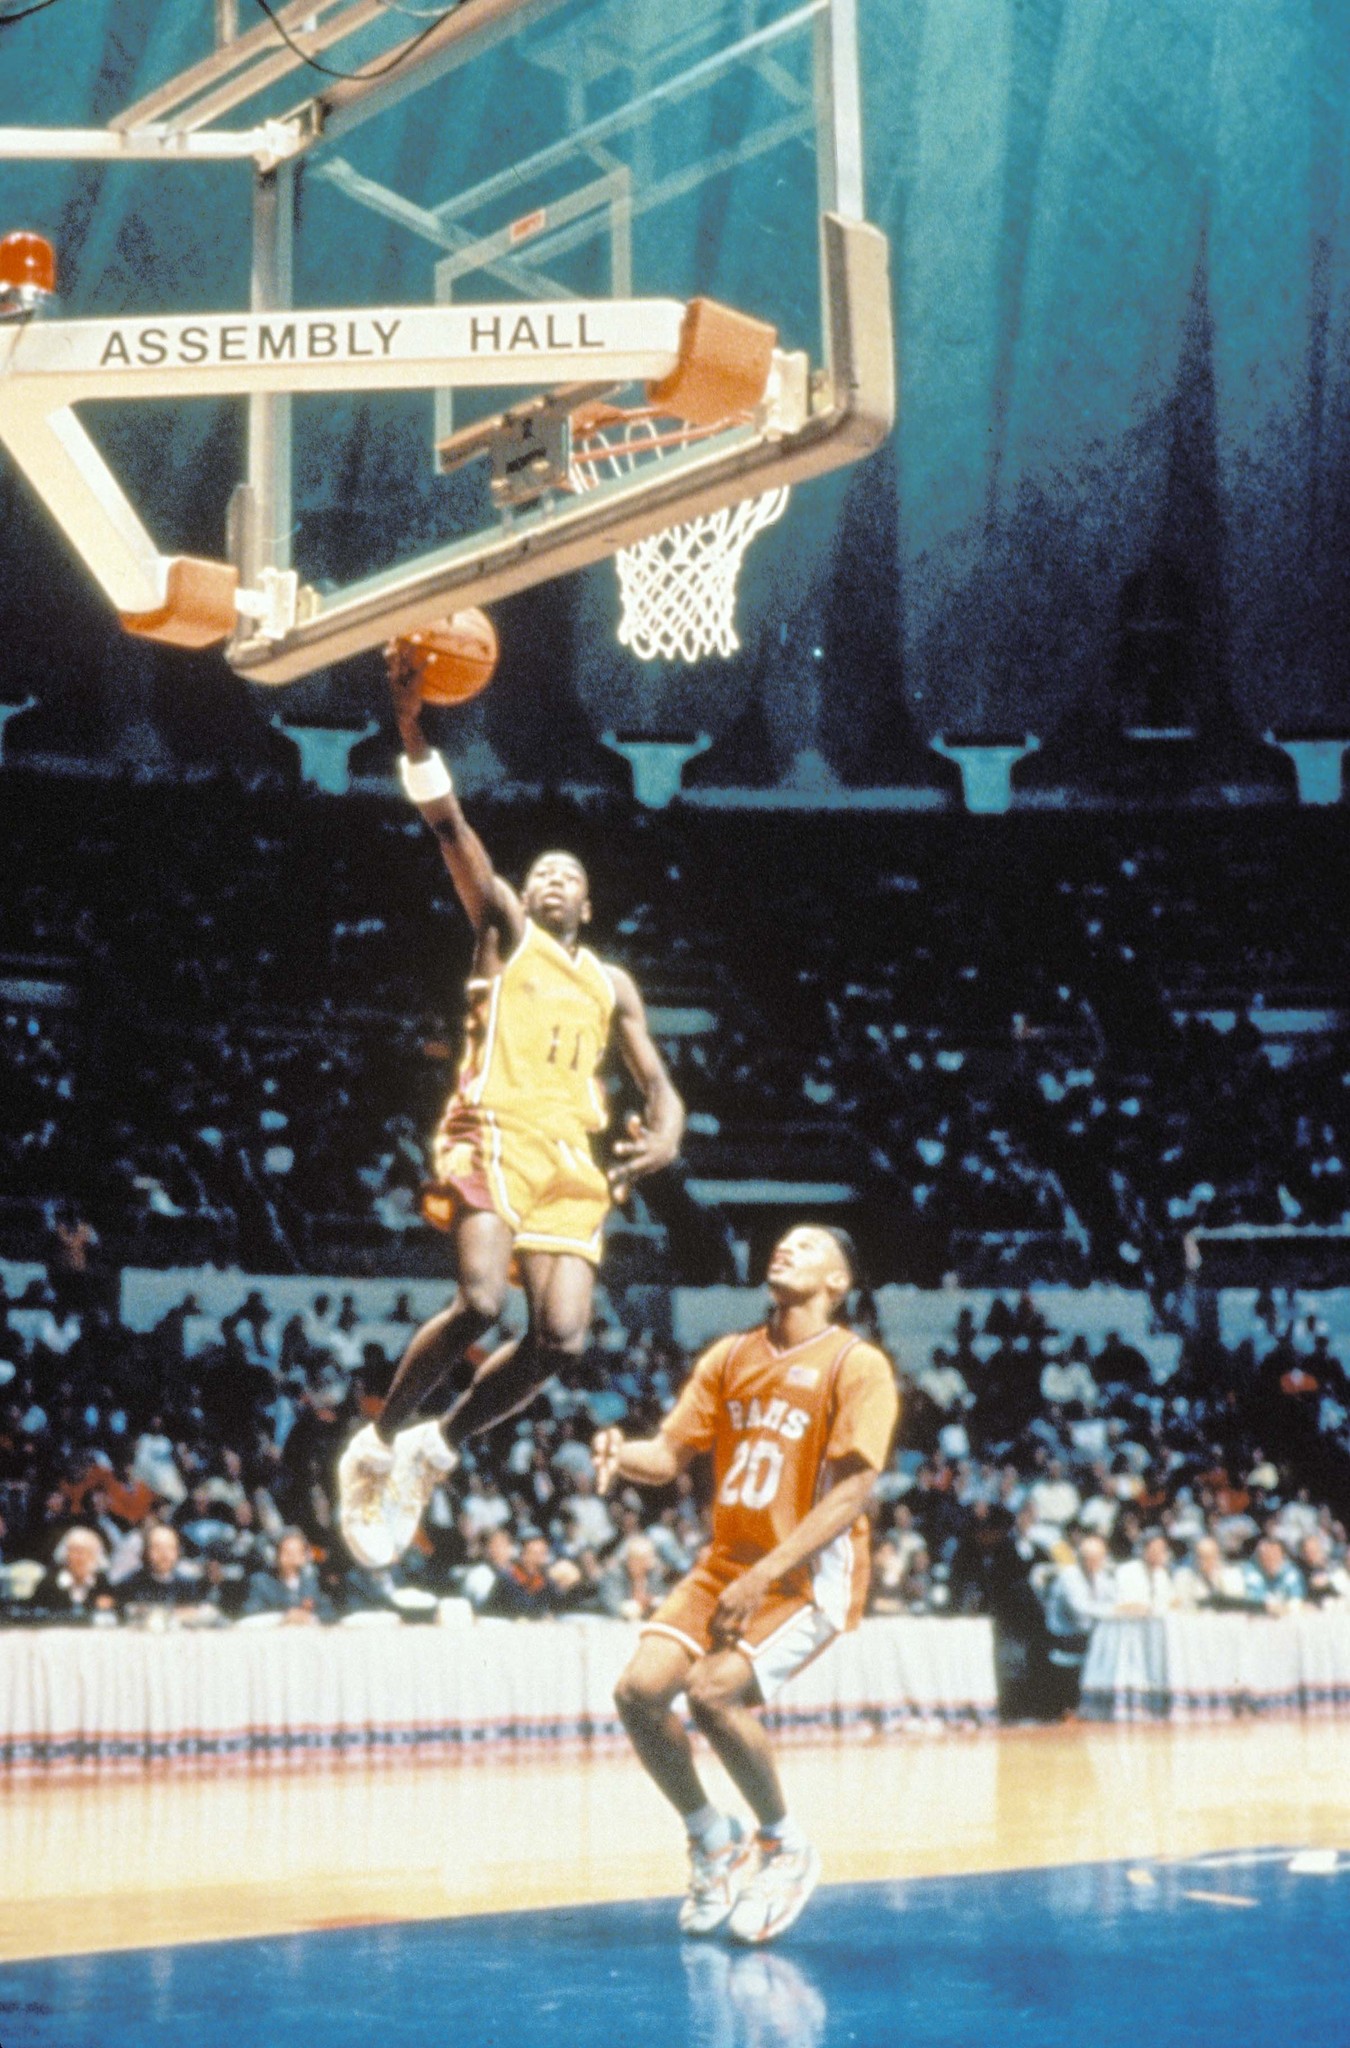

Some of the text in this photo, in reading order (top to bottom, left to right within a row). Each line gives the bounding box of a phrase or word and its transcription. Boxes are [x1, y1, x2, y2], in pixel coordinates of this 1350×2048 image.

[100, 313, 606, 366] ASSEMBLY HALL
[547, 1024, 581, 1071] 11
[718, 1440, 785, 1510] 20
